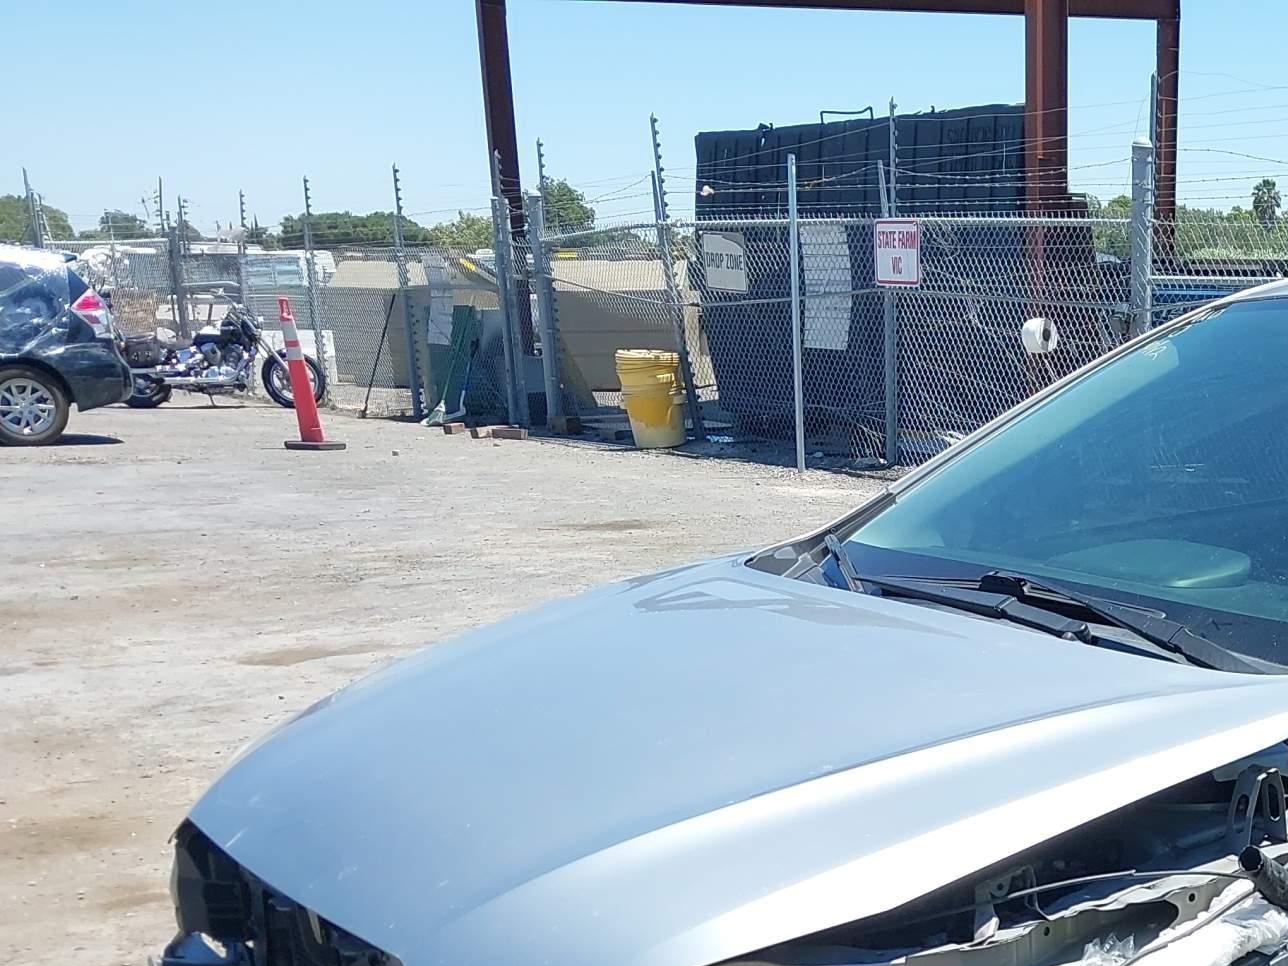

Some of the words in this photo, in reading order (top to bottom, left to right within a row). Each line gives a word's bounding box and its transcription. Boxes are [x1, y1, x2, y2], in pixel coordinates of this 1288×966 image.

[878, 230, 896, 249] STATE
[898, 231, 917, 249] FARM
[706, 252, 724, 270] DROP
[725, 253, 744, 271] ZONE
[891, 256, 903, 274] VIC
